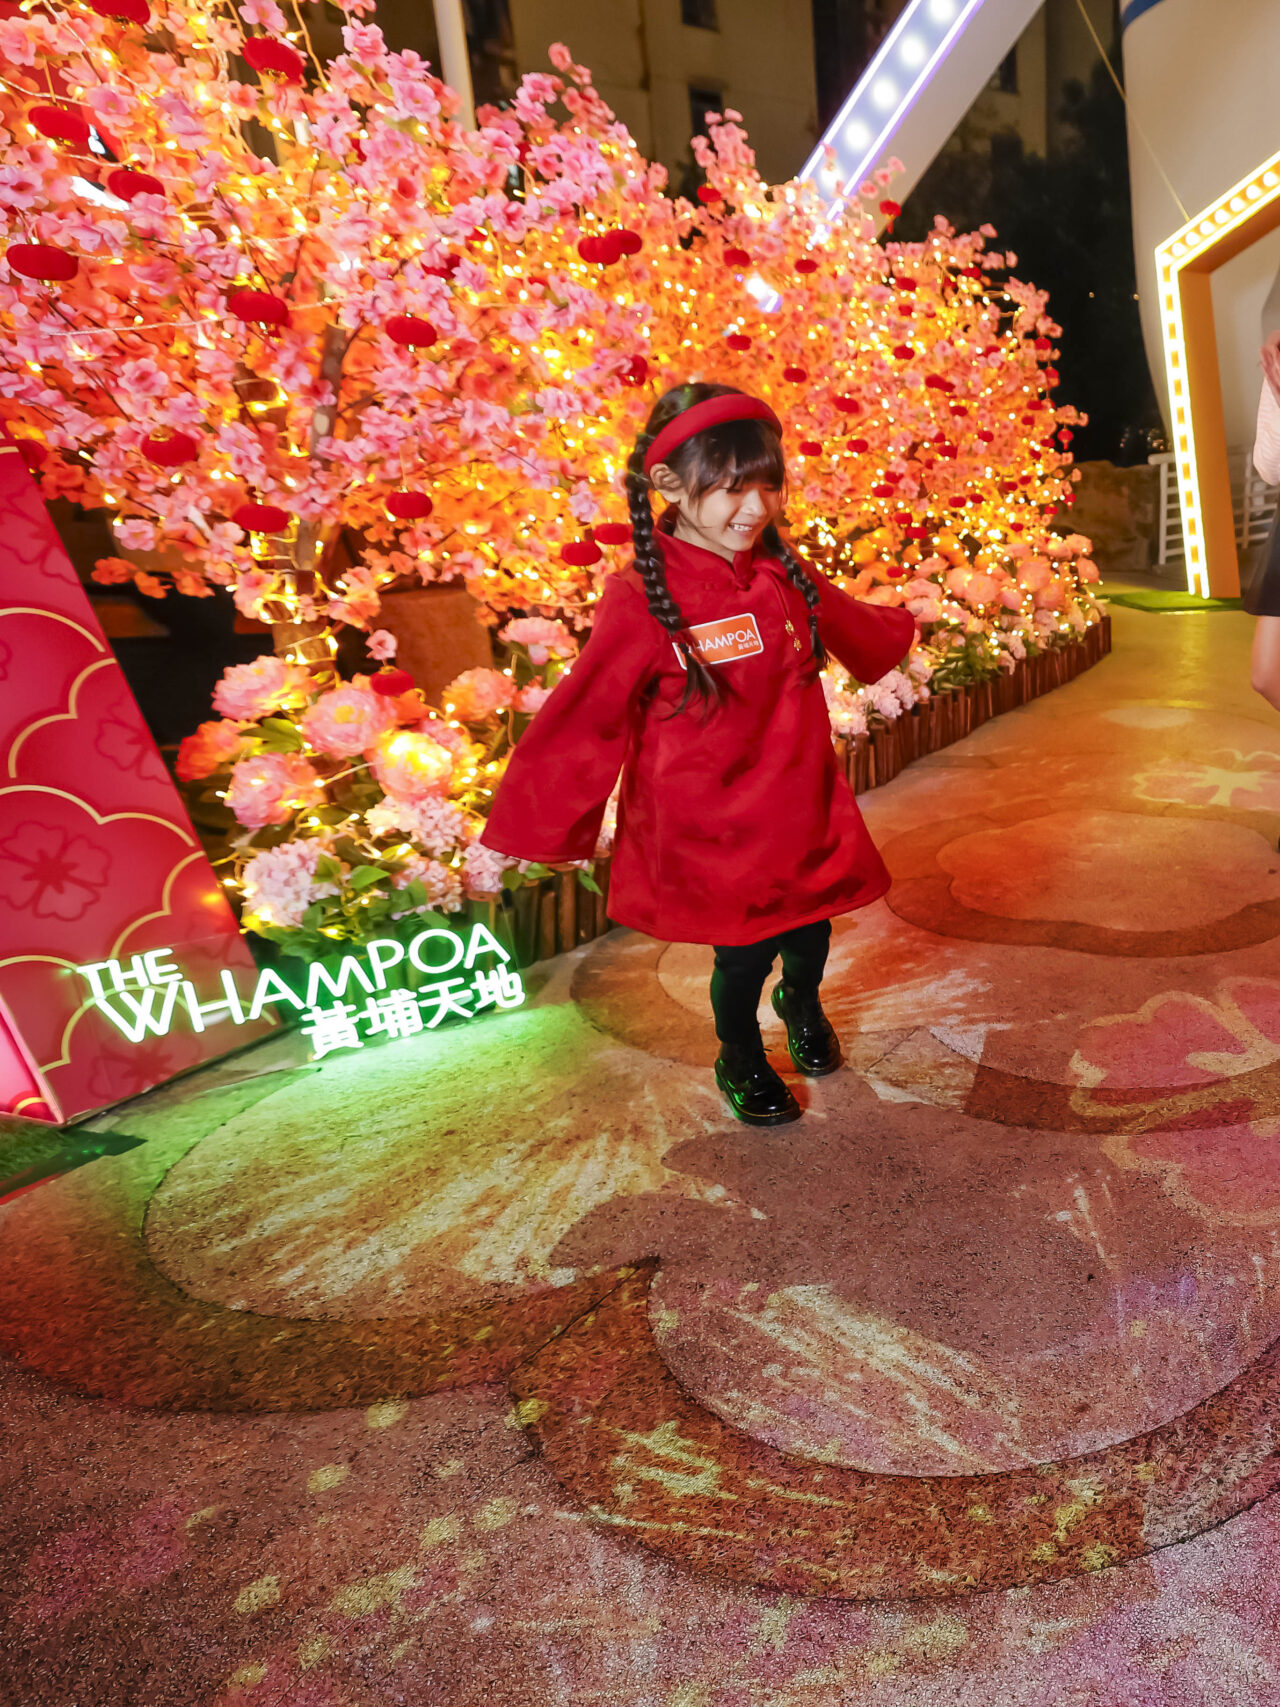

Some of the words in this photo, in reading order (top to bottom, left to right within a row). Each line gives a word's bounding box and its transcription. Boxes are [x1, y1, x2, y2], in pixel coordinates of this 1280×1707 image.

[76, 947, 183, 1000] THE
[95, 922, 511, 1044] WHAMPOA
[300, 963, 526, 1061] 黃埔天地
